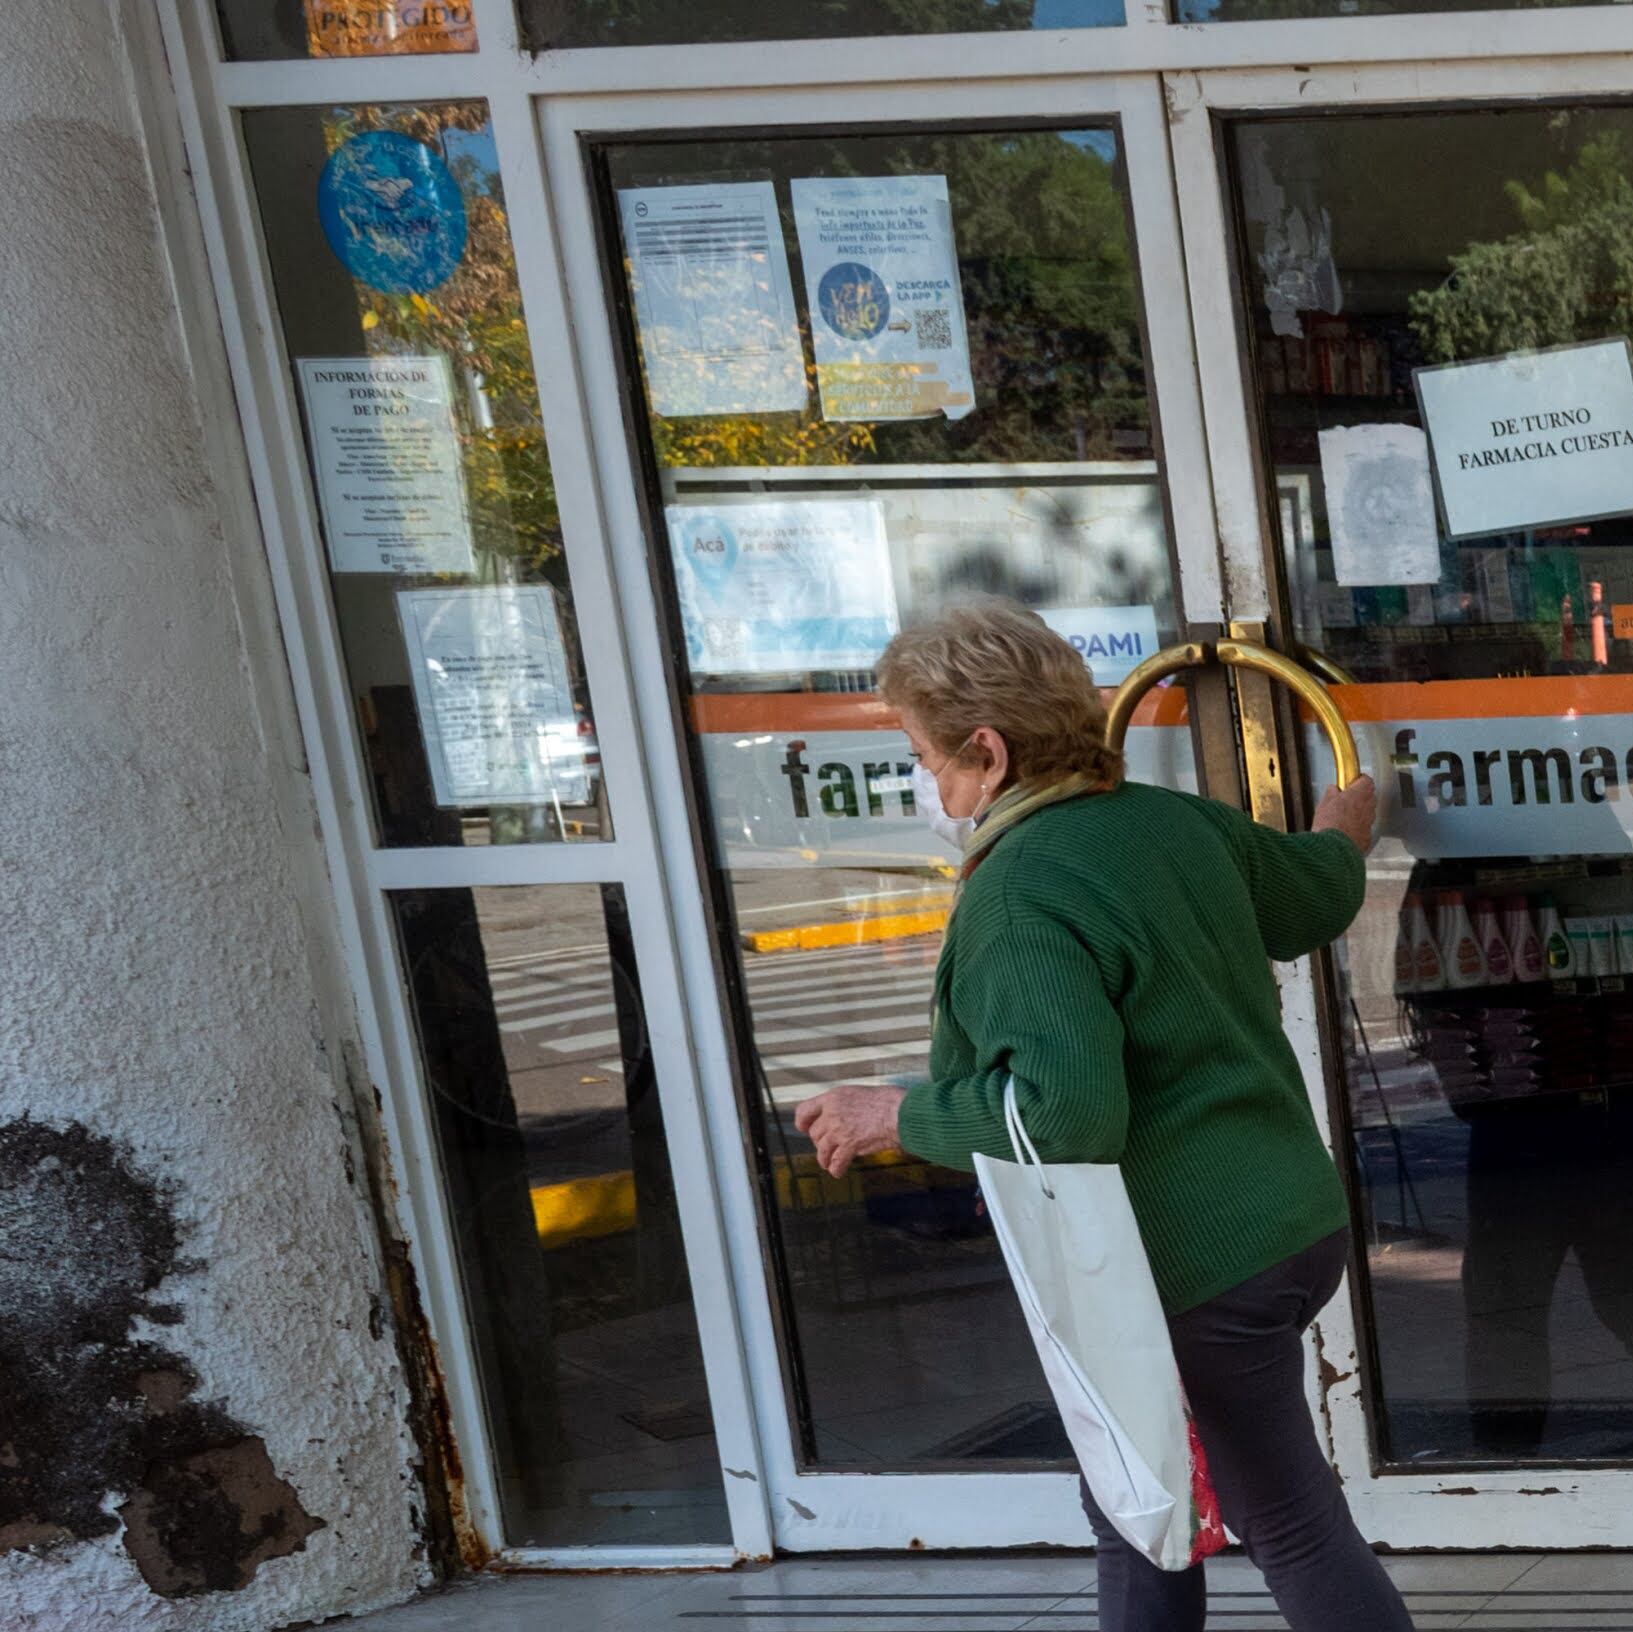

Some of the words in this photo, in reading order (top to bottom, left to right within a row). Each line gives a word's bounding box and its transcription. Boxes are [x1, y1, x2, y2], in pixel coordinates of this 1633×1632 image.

[320, 6, 472, 31] PROTGIDO
[411, 371, 430, 383] DE
[349, 387, 405, 400] FORMAS
[353, 404, 372, 416] DE
[374, 404, 410, 416] PAGO
[1490, 417, 1520, 438] DE
[1520, 407, 1592, 433] TURNO
[1458, 441, 1558, 471] FARMACIA
[1068, 632, 1143, 658] PAMI
